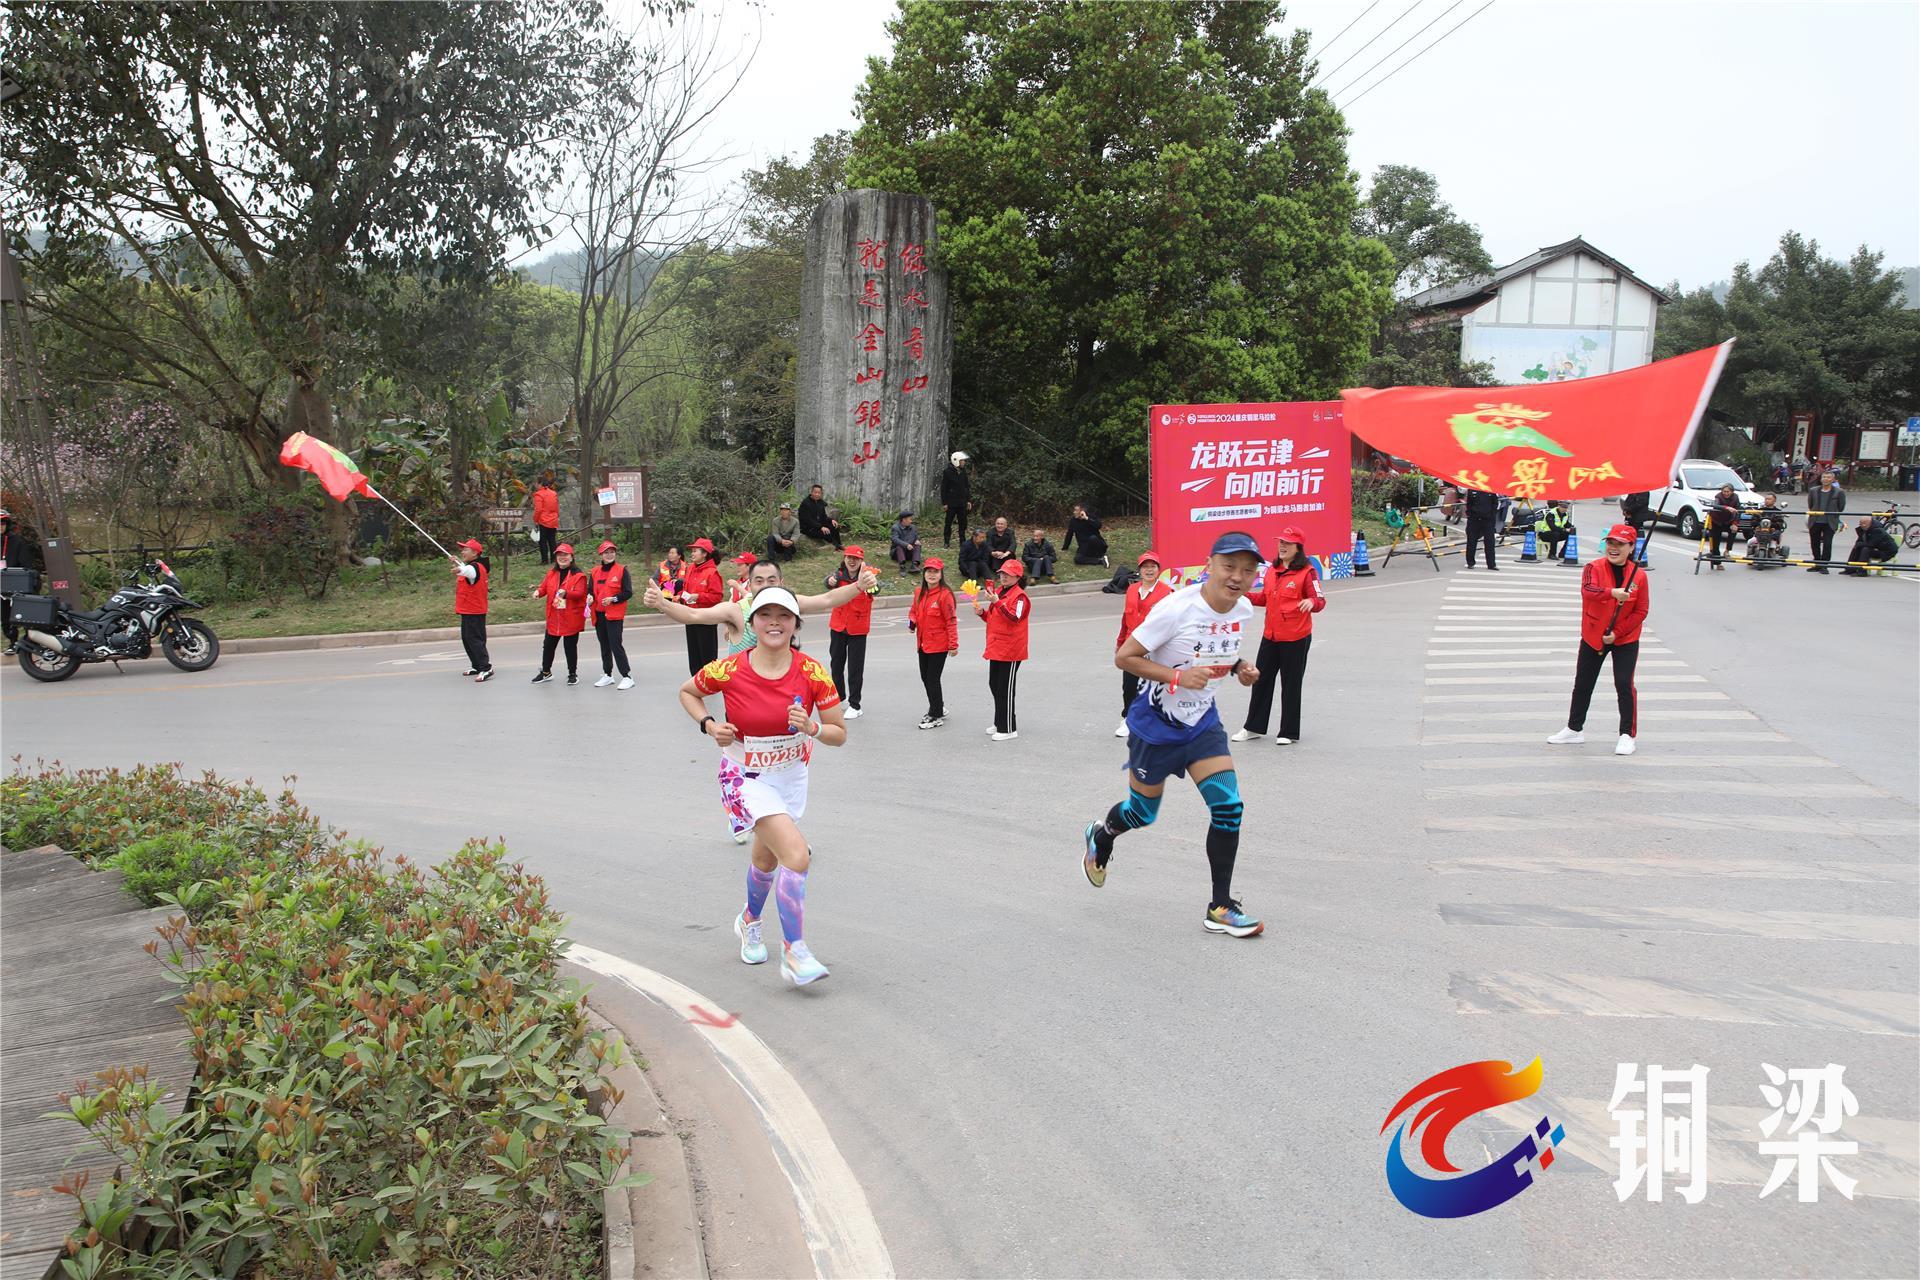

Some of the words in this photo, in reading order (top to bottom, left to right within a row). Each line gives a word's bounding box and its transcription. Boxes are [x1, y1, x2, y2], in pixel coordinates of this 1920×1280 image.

[1190, 438, 1294, 470] 龙跃云津
[1224, 468, 1325, 500] 向阳前行
